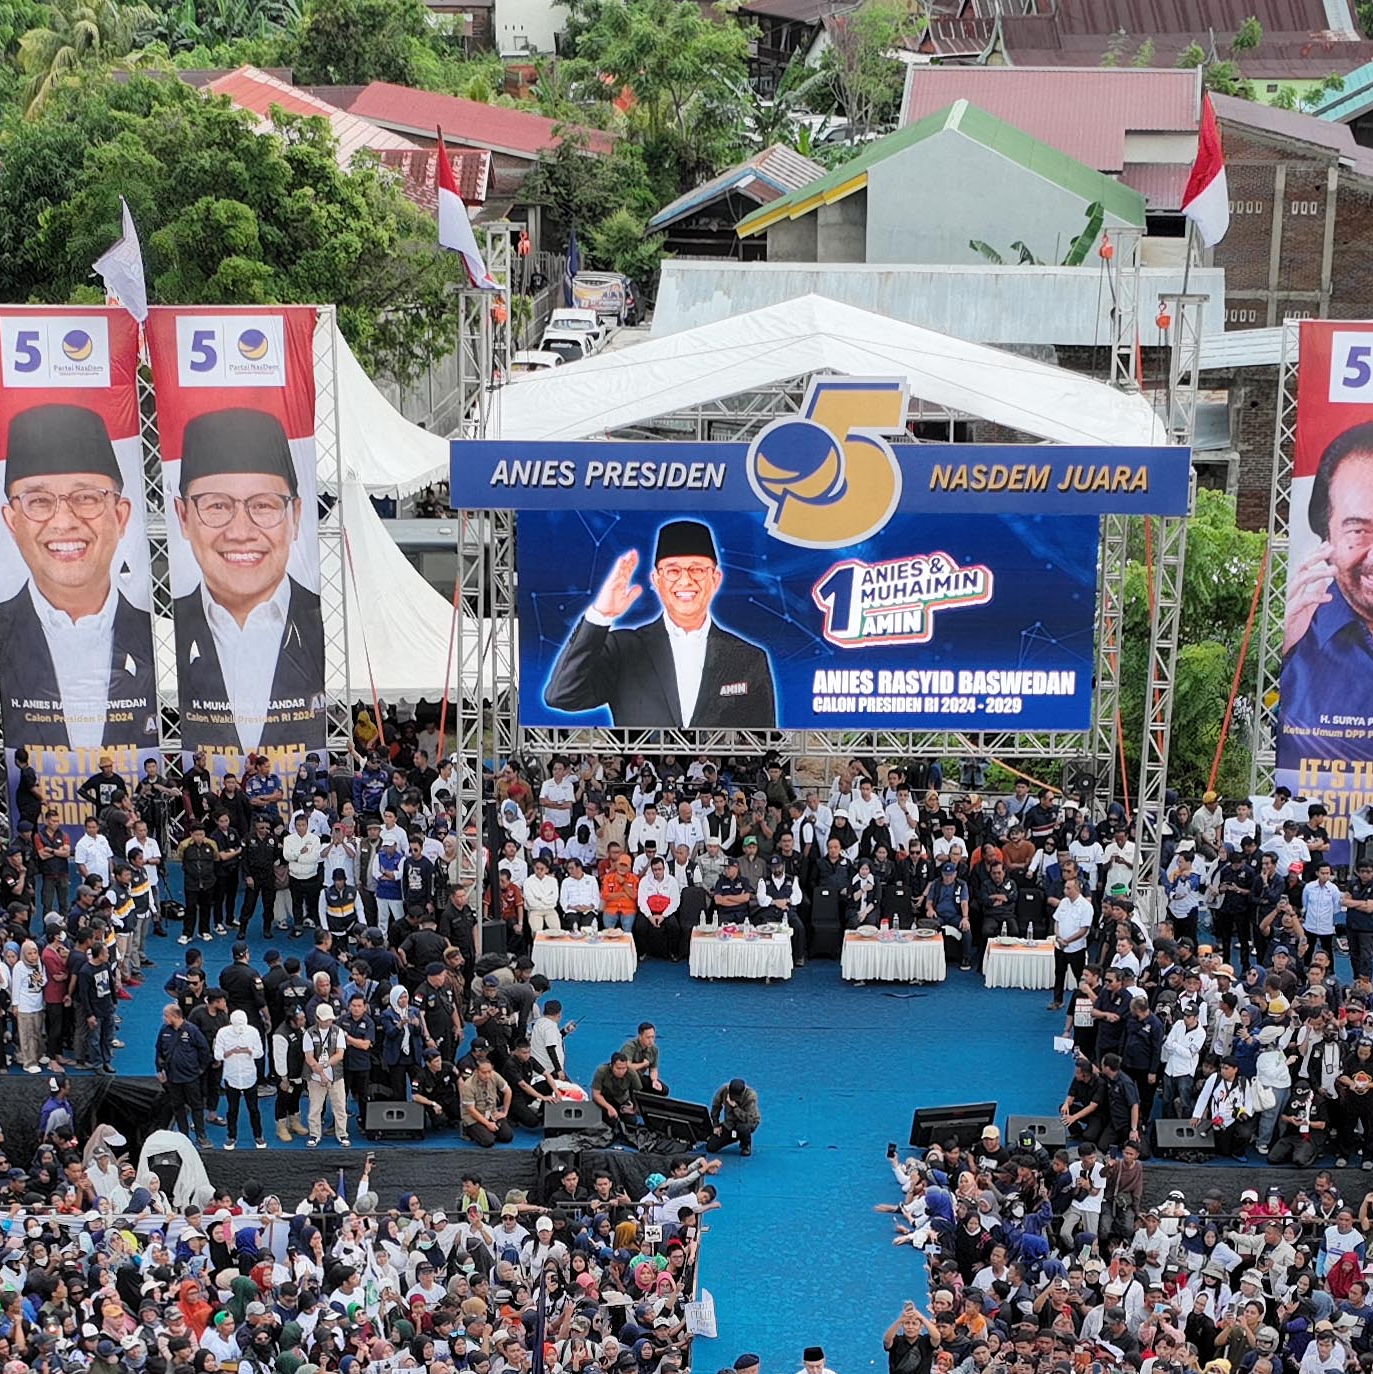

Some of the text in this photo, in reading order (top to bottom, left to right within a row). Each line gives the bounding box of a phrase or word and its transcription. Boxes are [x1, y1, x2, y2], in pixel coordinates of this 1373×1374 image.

[13, 330, 42, 373] 5
[190, 330, 218, 373] 5
[1342, 346, 1372, 389] 5
[490, 459, 726, 491] ANIES PRESIDEN
[930, 463, 1150, 494] NASDEM JUARA
[859, 570, 979, 603] MUHAIMIN
[860, 557, 946, 587] ANIES &
[818, 565, 857, 634] 1
[862, 611, 924, 637] AMIN
[812, 670, 1076, 697] ANIES RASYID BASWEDAN
[22, 698, 49, 710] ANIES
[25, 713, 51, 723] Calon
[108, 712, 134, 723] 2024
[185, 711, 208, 723] Calon
[292, 711, 316, 722] 2024
[812, 697, 855, 714] CALON
[857, 697, 924, 714] PRESIDEN
[926, 697, 940, 714] RI
[940, 697, 976, 714] 2024
[985, 697, 1023, 714] 2029
[1282, 725, 1311, 737] Ketua
[1312, 726, 1344, 738] Umum
[1344, 728, 1365, 740] DPP
[1319, 714, 1330, 725] H.
[1332, 714, 1366, 727] SURYA
[1298, 758, 1346, 790] IT'S
